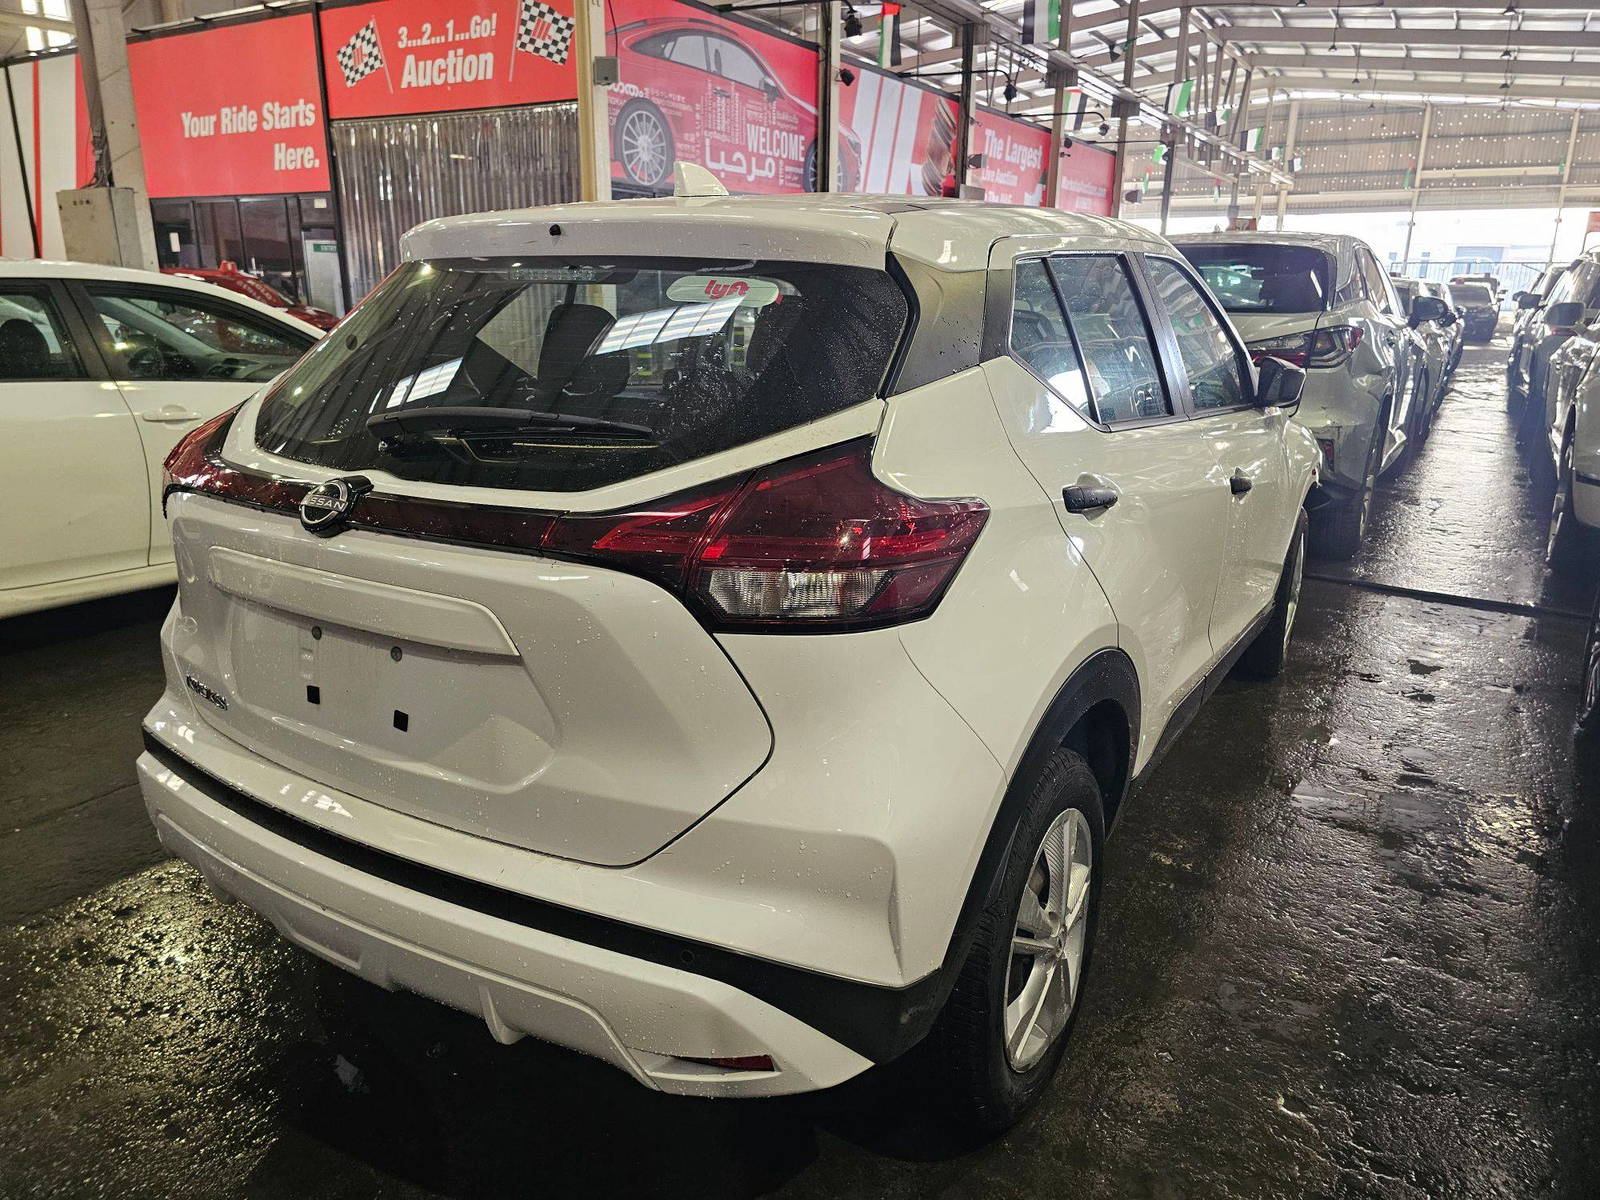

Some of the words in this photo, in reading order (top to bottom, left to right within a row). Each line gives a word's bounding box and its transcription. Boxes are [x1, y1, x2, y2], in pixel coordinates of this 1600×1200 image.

[398, 13, 497, 48] 3...2...1...Go!
[400, 48, 494, 89] Auction
[181, 111, 217, 138] Your
[220, 104, 258, 135] Ride
[262, 98, 316, 131] Starts
[274, 142, 320, 171] Here.
[706, 138, 775, 182] مرحبا
[746, 123, 805, 162] WELCOME
[985, 128, 1004, 160] The
[1005, 135, 1043, 172] Largest
[704, 279, 750, 299] lyft
